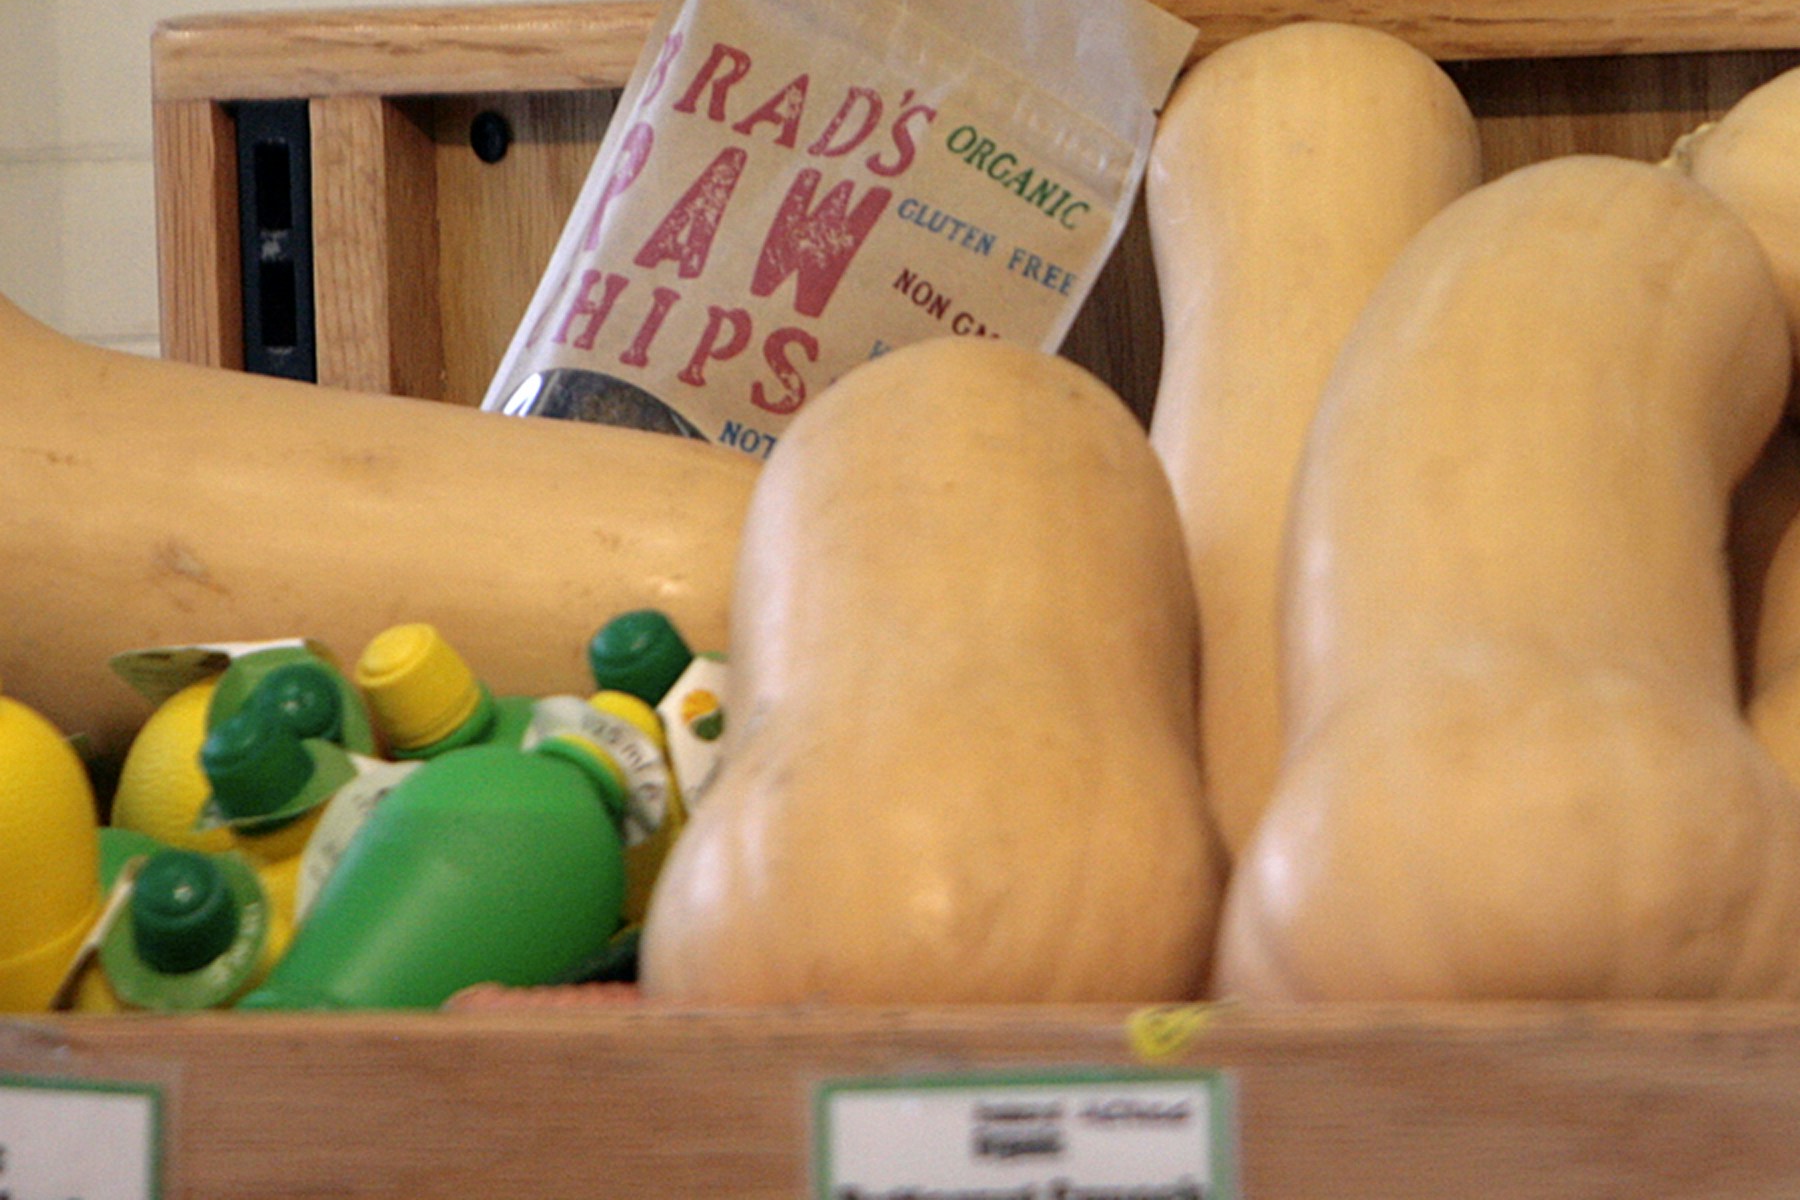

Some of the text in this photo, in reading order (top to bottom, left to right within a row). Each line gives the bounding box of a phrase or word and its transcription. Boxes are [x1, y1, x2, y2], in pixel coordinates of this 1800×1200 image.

[945, 124, 1091, 231] ORGANIC
[892, 268, 953, 322] NON
[896, 197, 1078, 297] GLUTEN FREE
